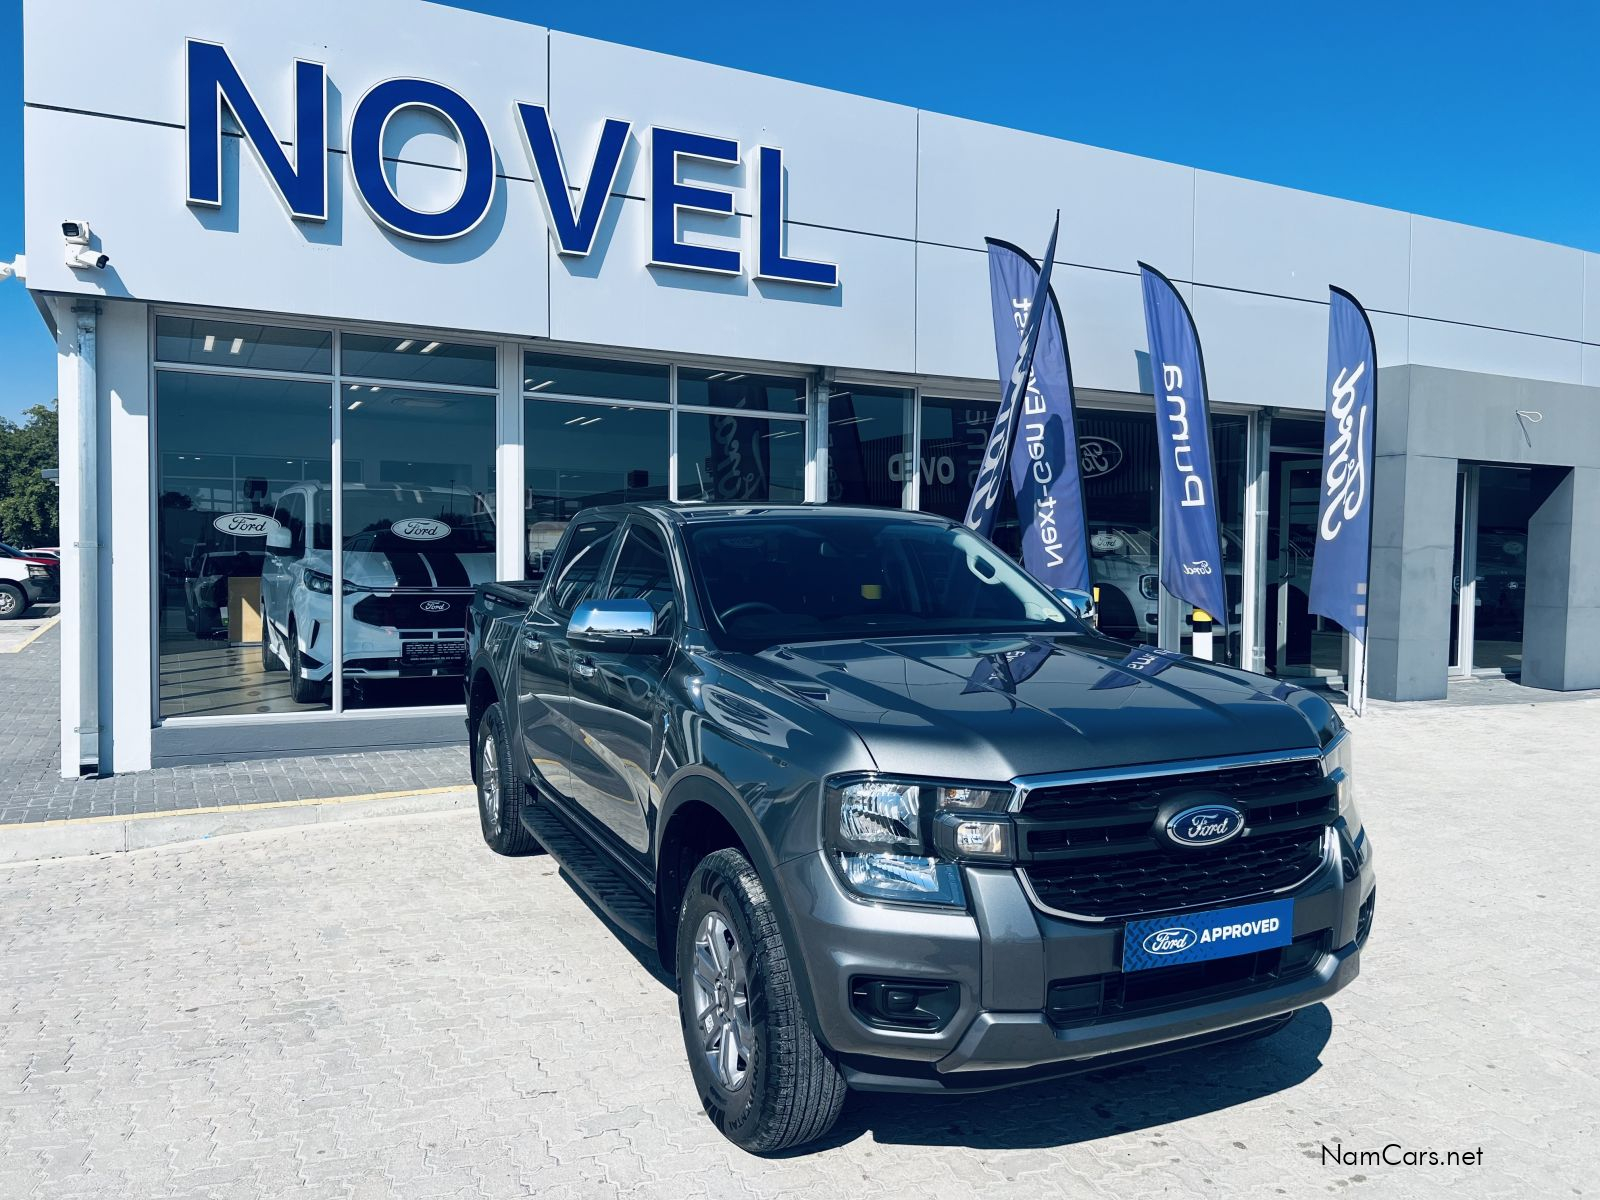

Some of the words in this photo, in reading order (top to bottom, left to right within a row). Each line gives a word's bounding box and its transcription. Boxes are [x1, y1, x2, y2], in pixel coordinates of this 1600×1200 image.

[185, 37, 838, 287] NOVEL
[228, 516, 266, 532] Ford
[404, 522, 438, 537] Ford
[1188, 814, 1228, 838] Ford
[1152, 931, 1188, 951] Ford
[1200, 918, 1279, 944] APPROVED
